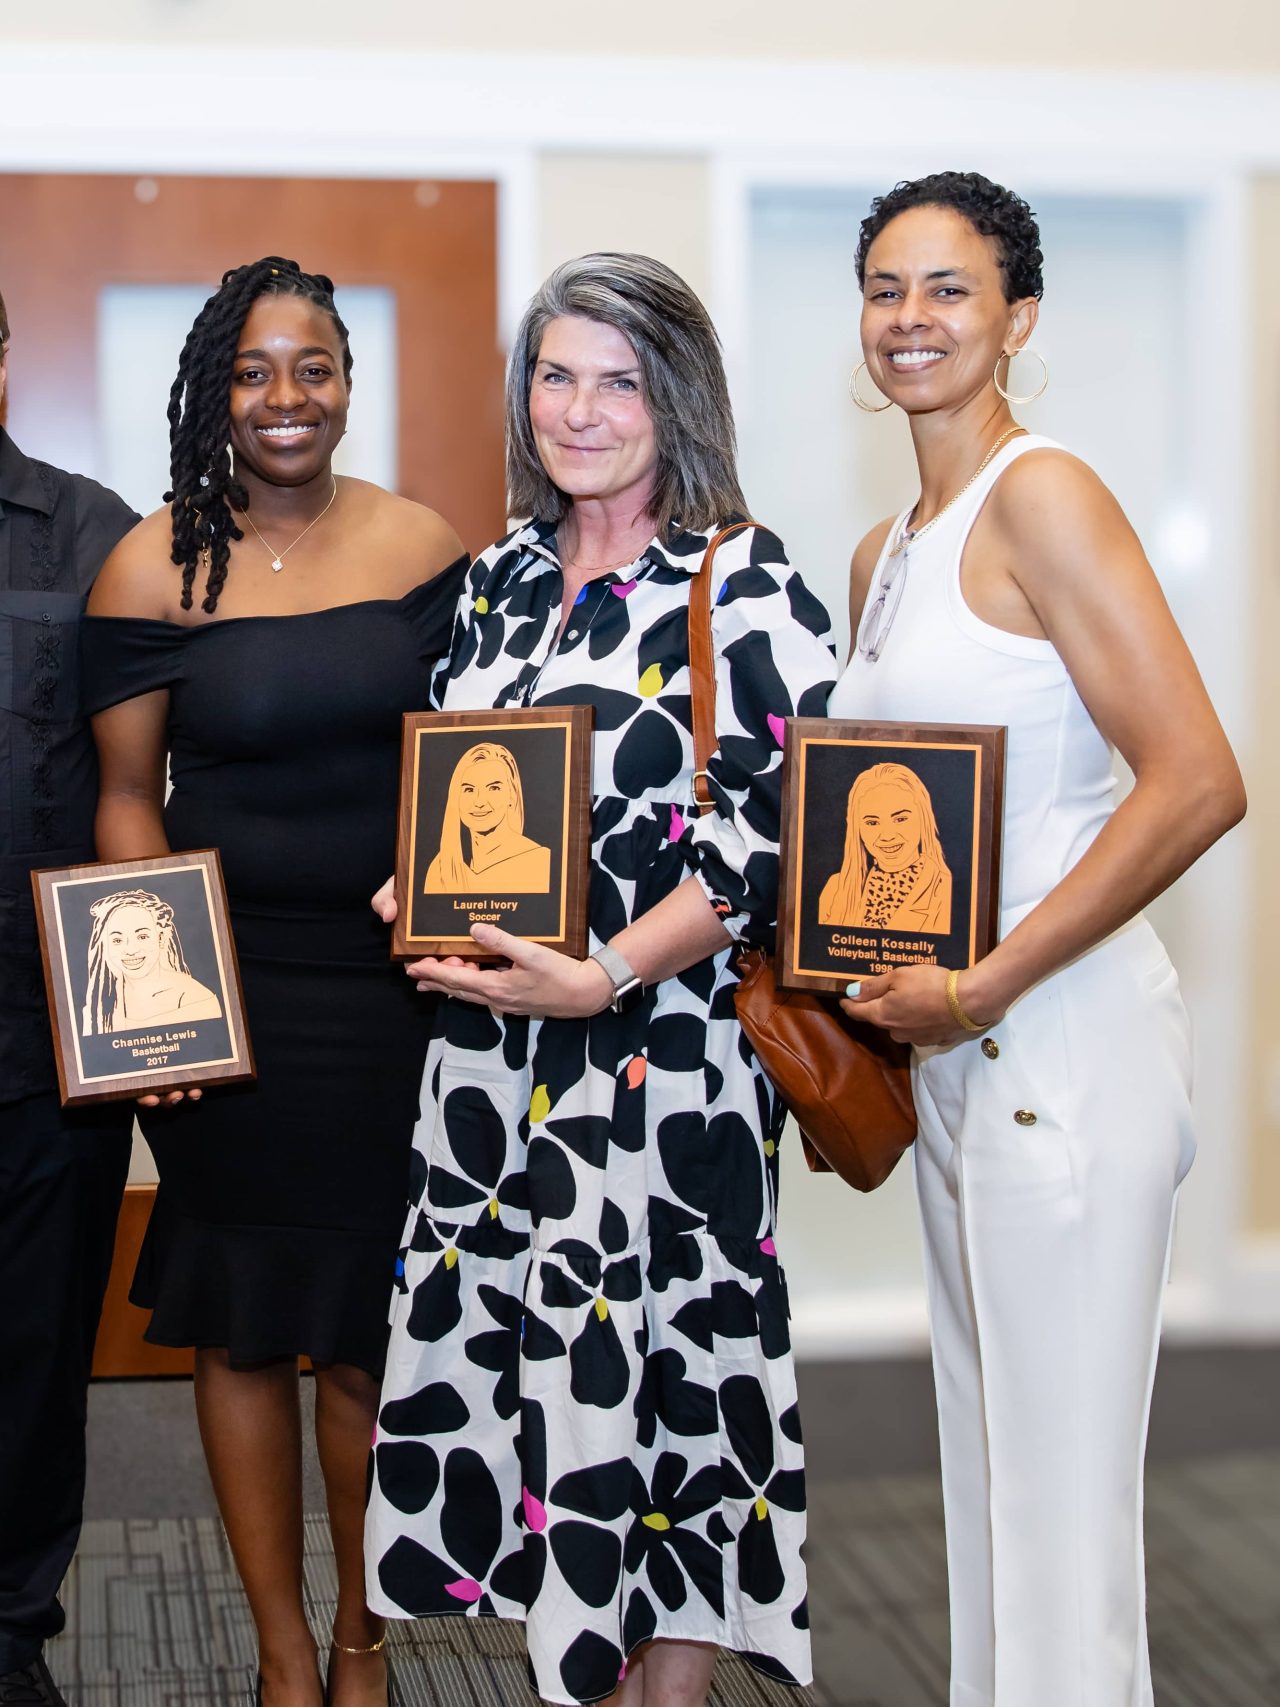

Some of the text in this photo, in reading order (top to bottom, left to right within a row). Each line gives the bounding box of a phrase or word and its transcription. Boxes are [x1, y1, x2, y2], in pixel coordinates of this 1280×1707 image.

[453, 900, 519, 912] Laurel Ivory
[468, 912, 501, 921] Soccer
[831, 933, 935, 954] Colleen Kossally
[827, 946, 937, 965] Volleyball, Basketball
[111, 1029, 198, 1049] Channise Lewis
[131, 1042, 180, 1057] Basketball
[146, 1055, 169, 1066] 2017
